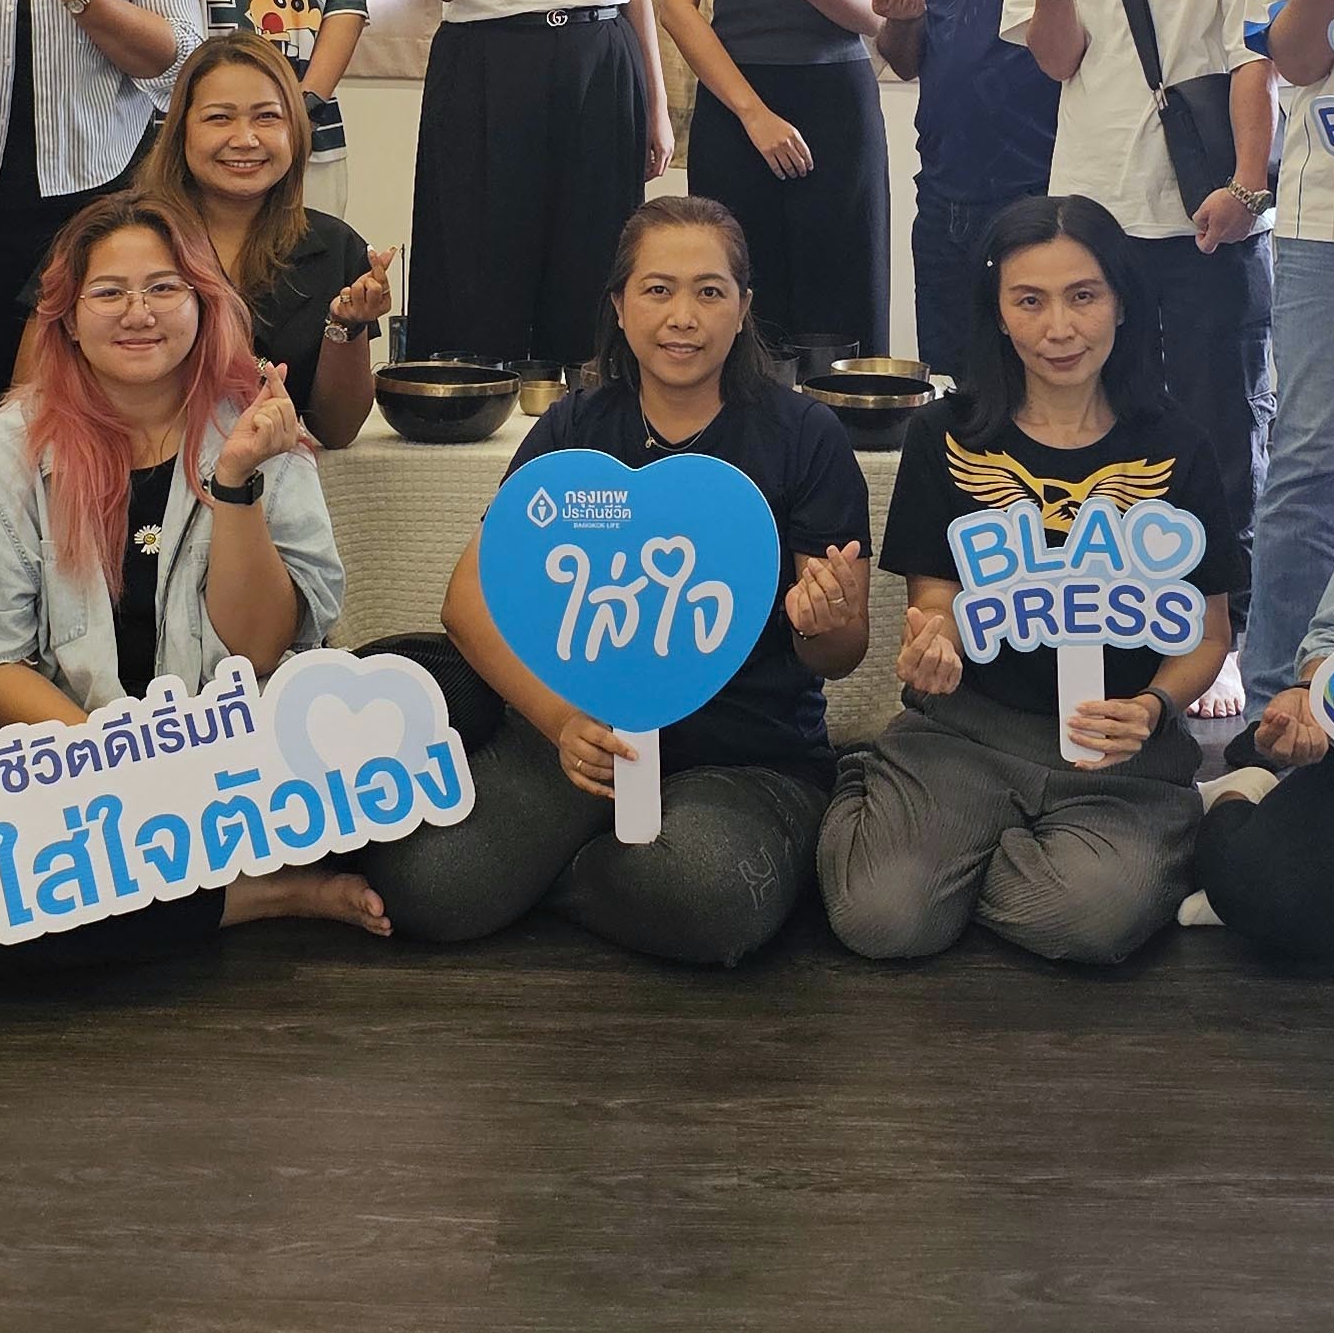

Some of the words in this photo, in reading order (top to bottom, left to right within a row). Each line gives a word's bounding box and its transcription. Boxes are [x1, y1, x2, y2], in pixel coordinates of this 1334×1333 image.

[562, 504, 632, 519] ประกันชีวิต
[564, 490, 628, 508] กรุงเทพ
[959, 509, 1125, 587] BLA
[545, 535, 734, 662] ใส่ใจ
[965, 584, 1193, 651] PRESS
